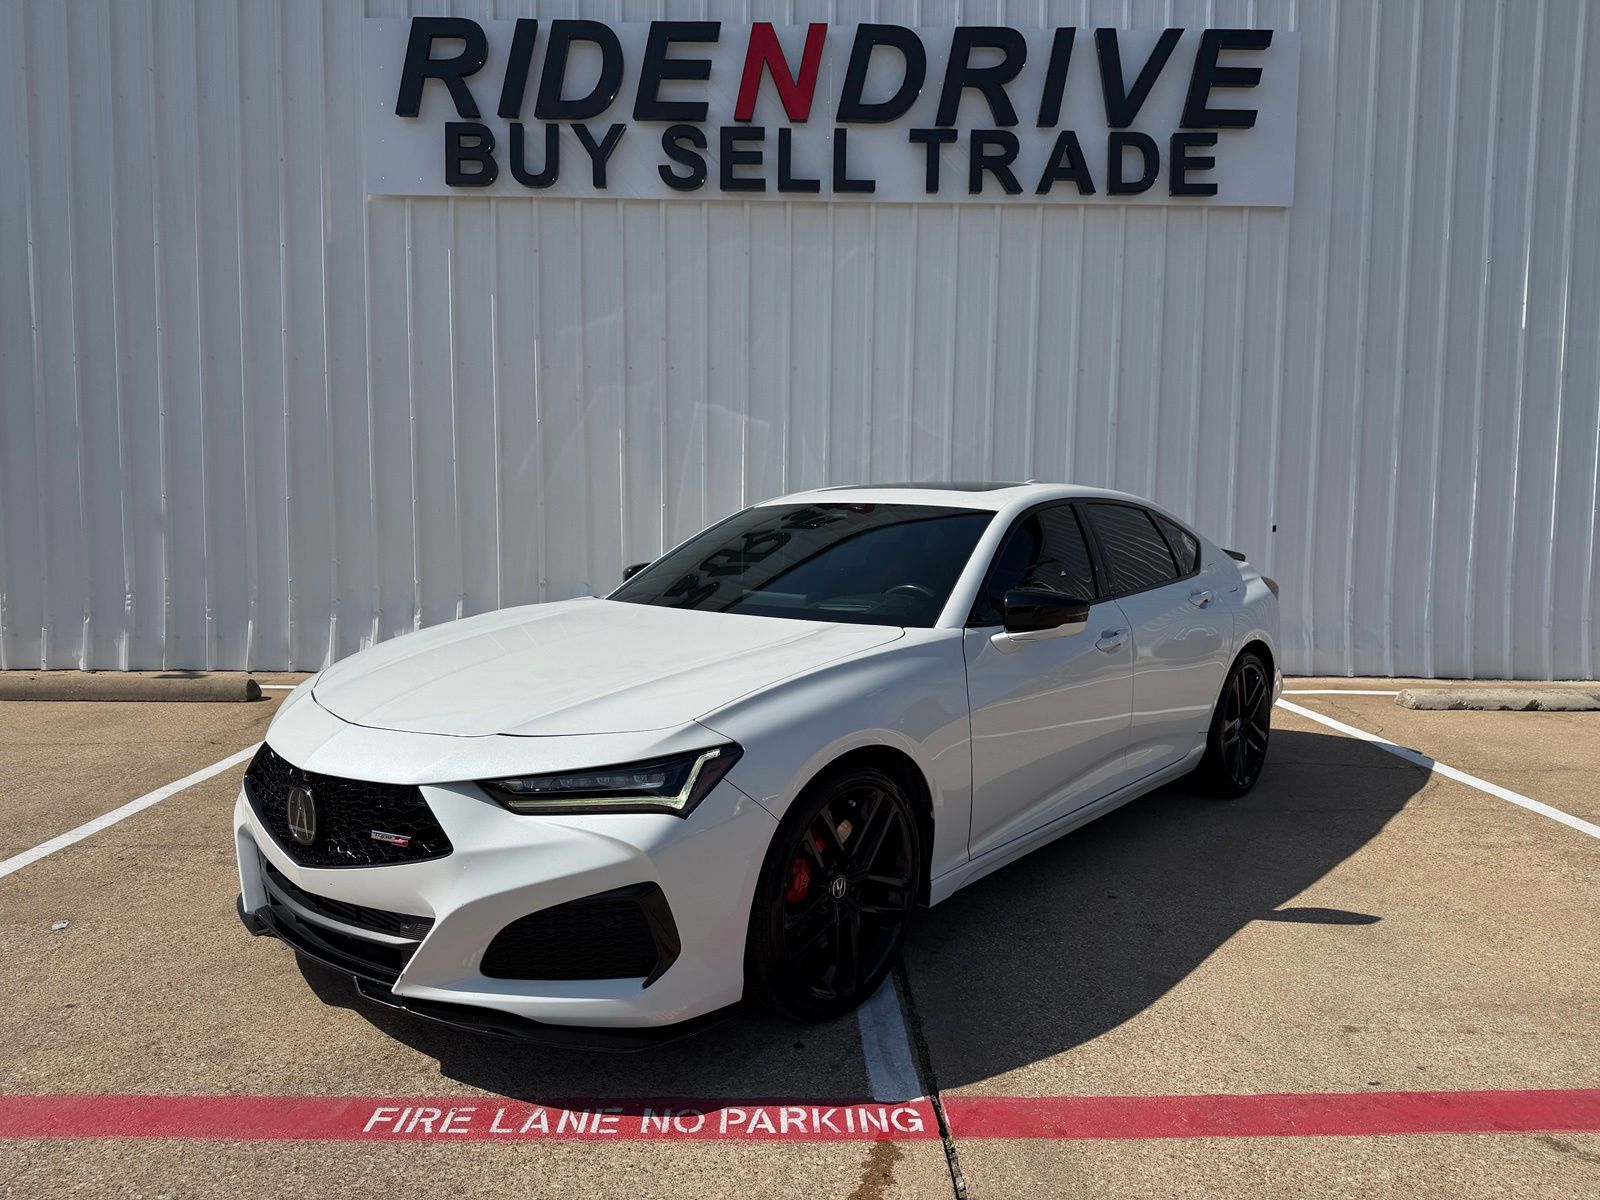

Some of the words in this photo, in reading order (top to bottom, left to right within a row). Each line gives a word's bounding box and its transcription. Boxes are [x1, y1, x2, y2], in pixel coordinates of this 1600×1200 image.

[445, 121, 627, 189] BUY
[657, 124, 876, 193] SELL
[908, 128, 1218, 196] TRADE
[362, 1107, 477, 1134] FIRE
[489, 1107, 624, 1134] LANE
[640, 1107, 705, 1134] NO
[719, 1107, 925, 1134] PARKING
